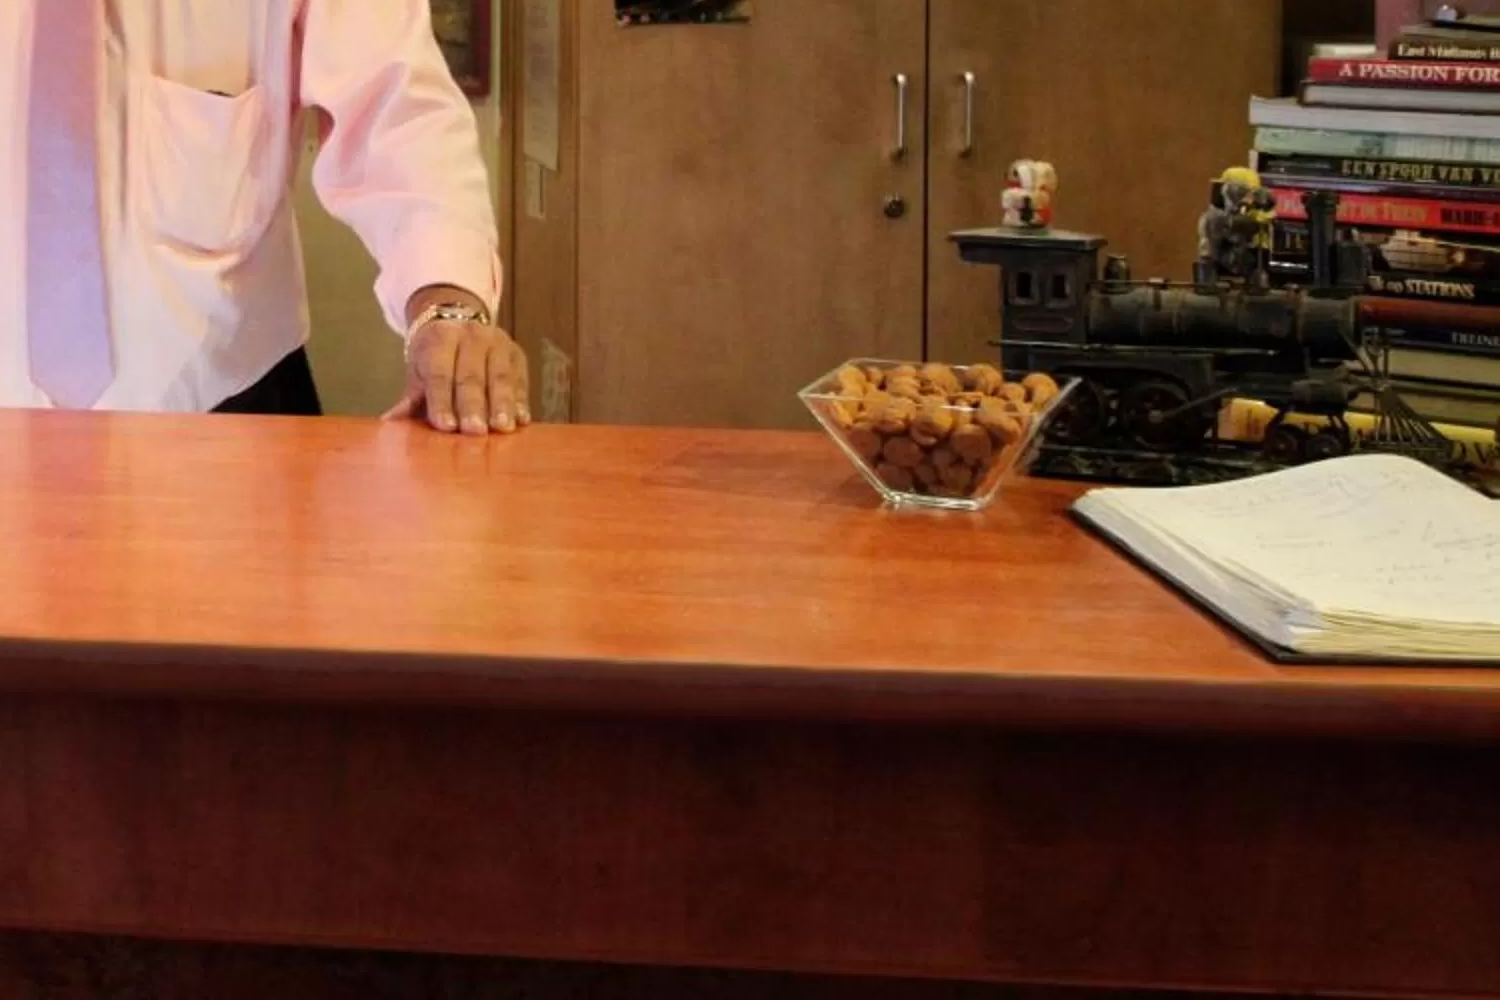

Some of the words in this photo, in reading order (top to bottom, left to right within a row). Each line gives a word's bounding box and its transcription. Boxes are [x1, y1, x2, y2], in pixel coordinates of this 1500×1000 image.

[1340, 63, 1353, 77] A
[1358, 63, 1449, 81] PASSION
[1451, 66, 1500, 83] FOR
